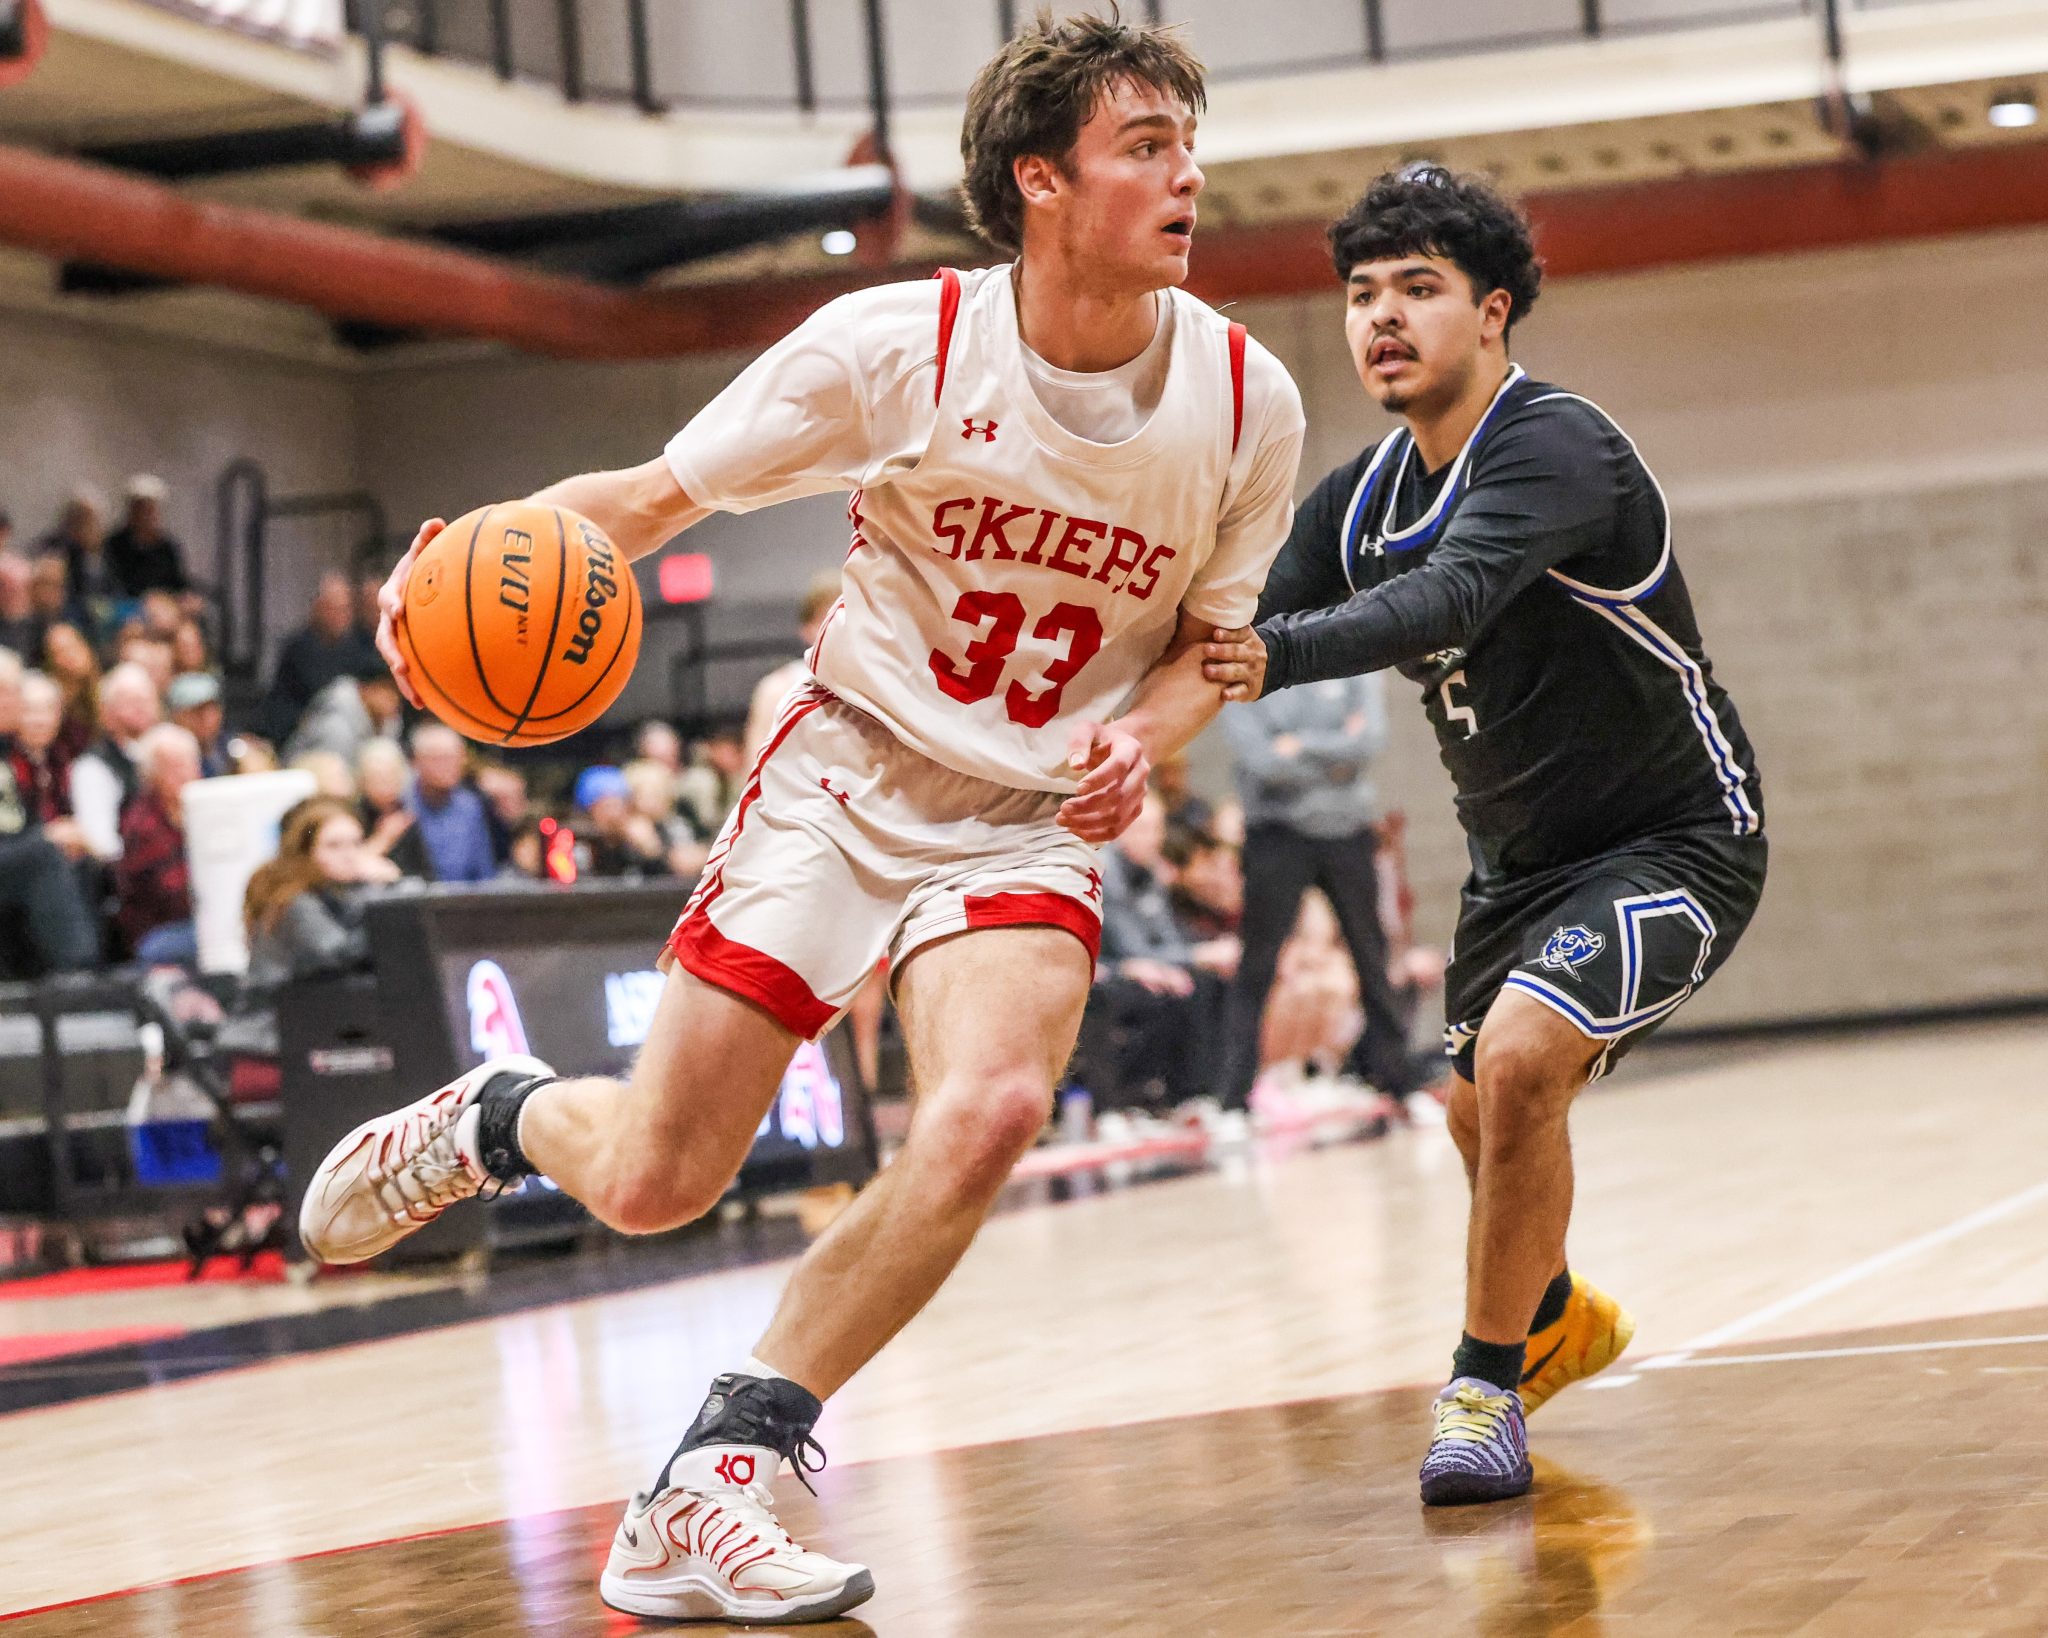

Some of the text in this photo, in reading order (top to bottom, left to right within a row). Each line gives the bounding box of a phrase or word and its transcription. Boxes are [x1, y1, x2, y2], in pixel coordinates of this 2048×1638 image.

[562, 521, 618, 666] Wilson
[931, 496, 1177, 600] SKIERS
[928, 590, 1104, 728] 33
[1440, 669, 1479, 740] 5
